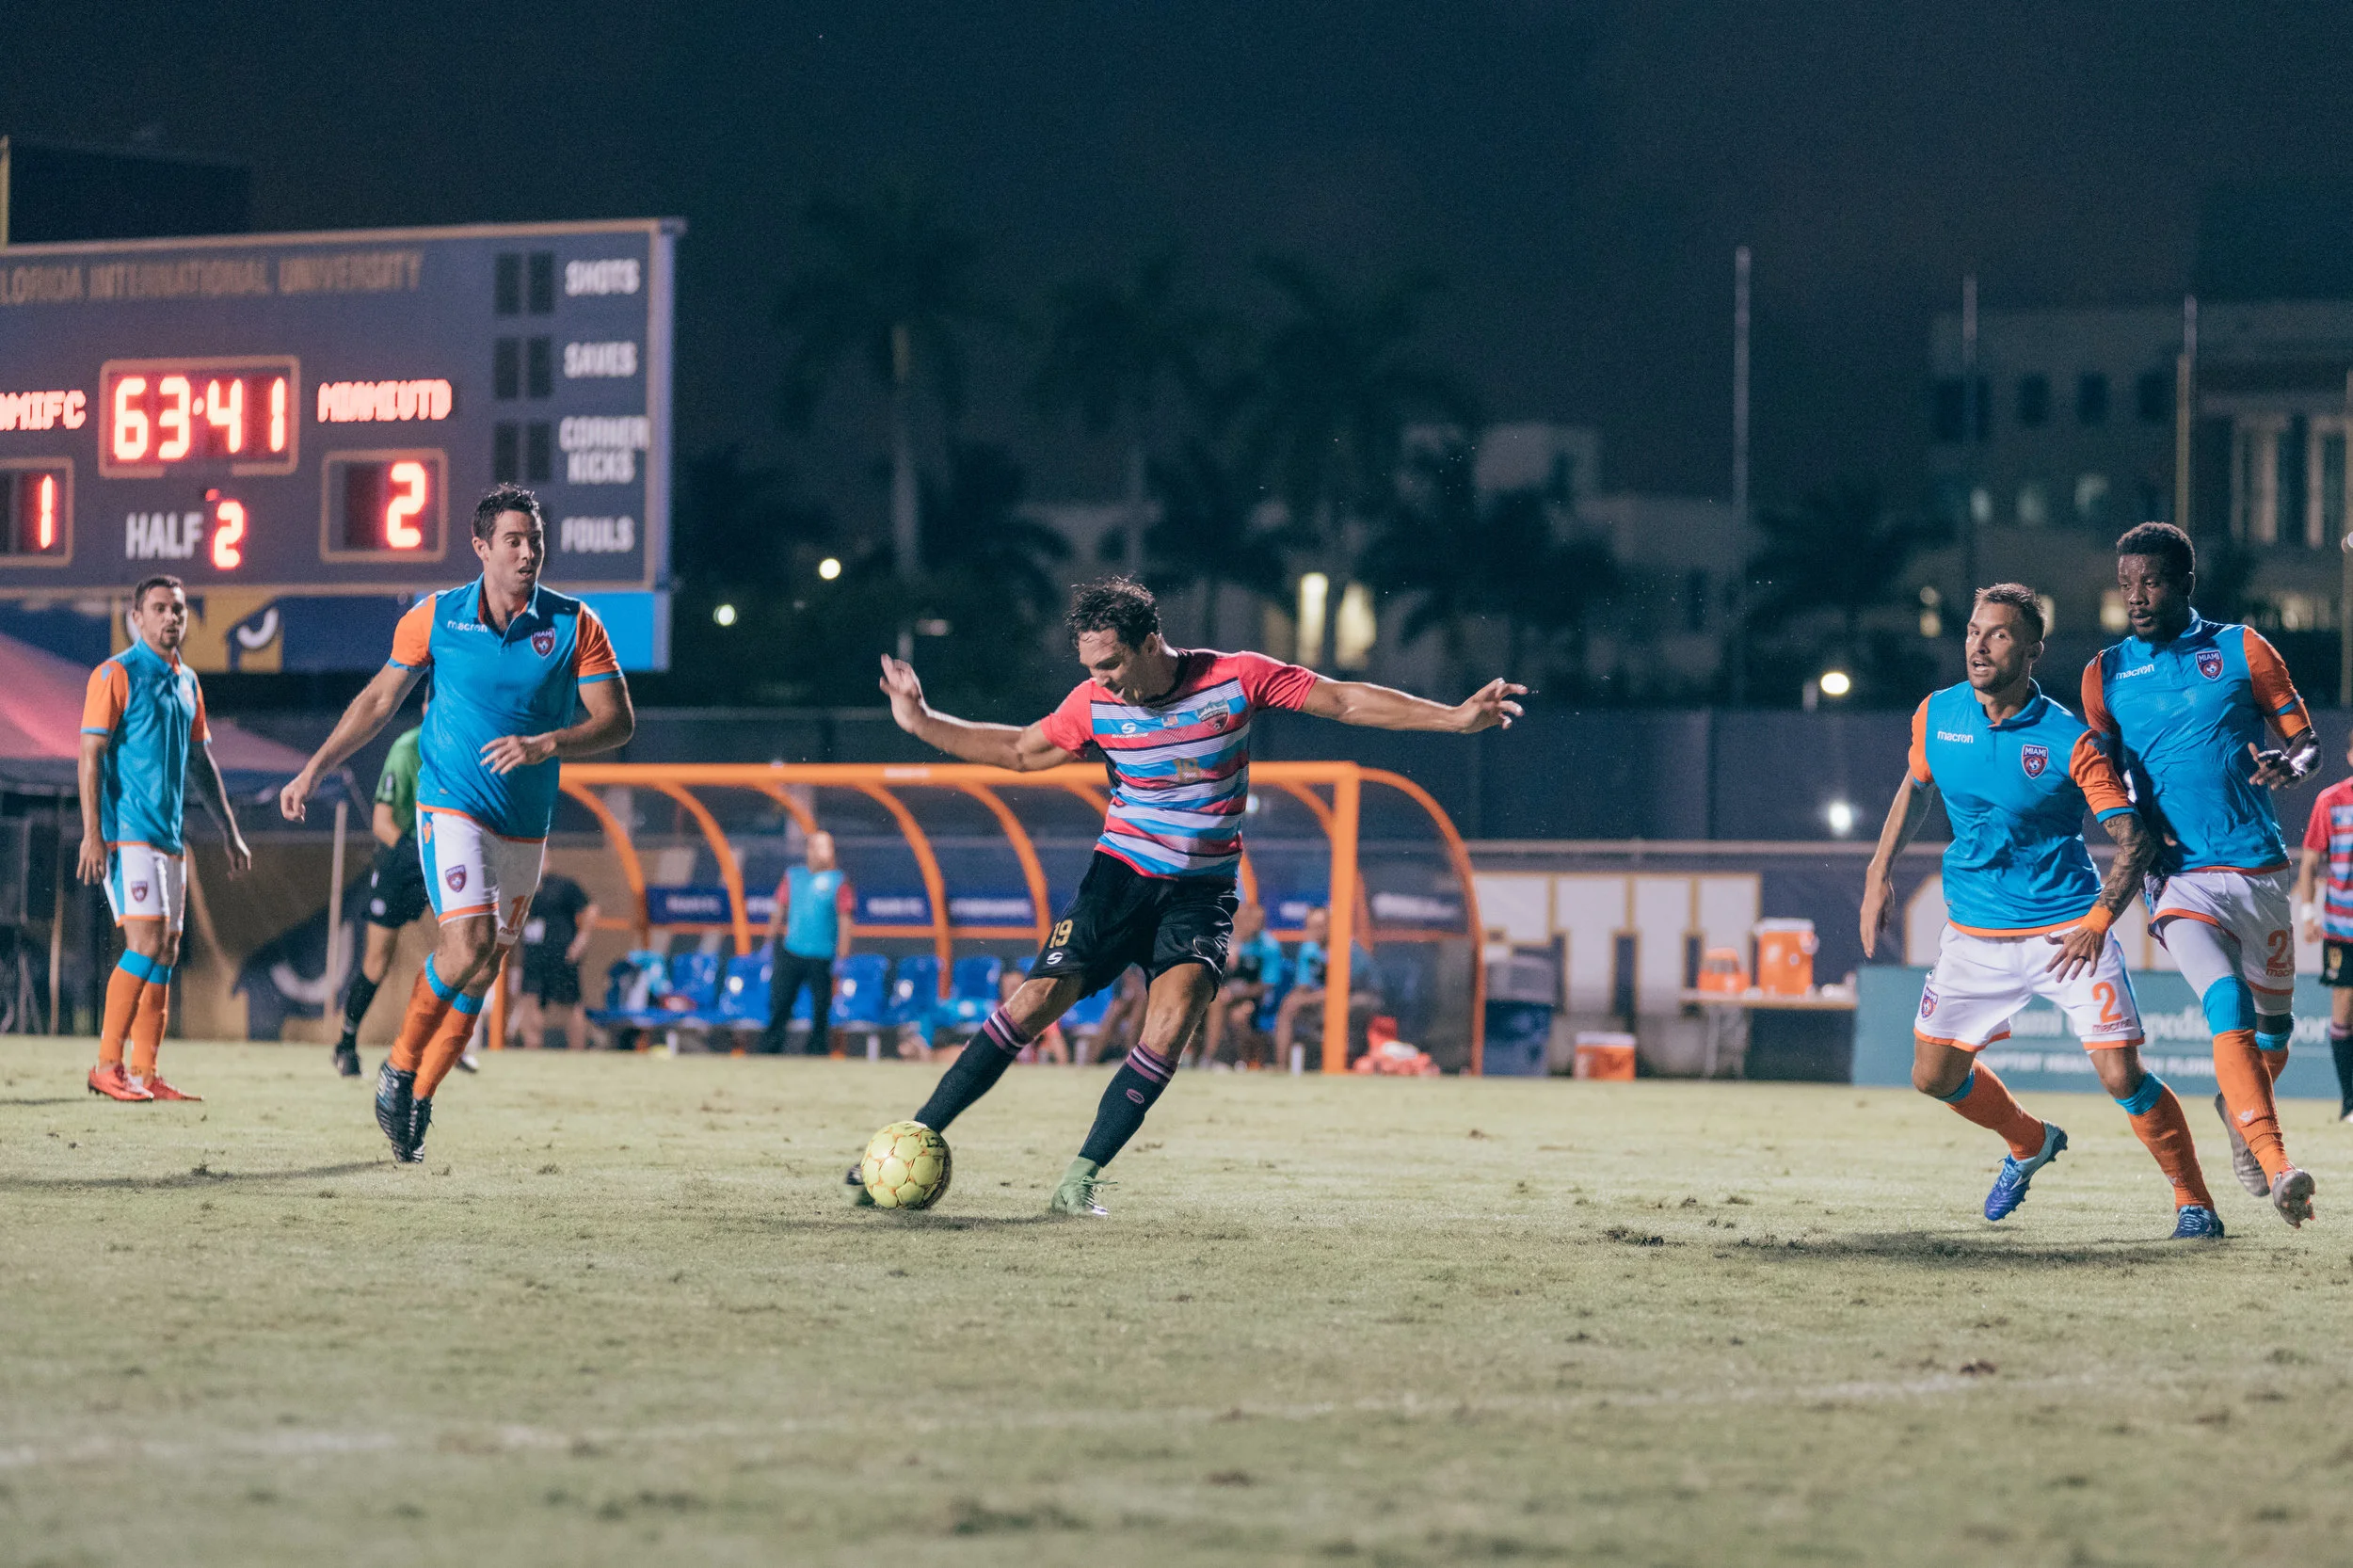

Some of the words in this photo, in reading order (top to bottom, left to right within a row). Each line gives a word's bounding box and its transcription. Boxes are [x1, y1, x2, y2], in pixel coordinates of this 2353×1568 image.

[0, 265, 83, 304] LORIDA
[565, 259, 640, 295] SHOTS
[564, 342, 637, 377] SAVES
[40, 474, 54, 549] 1
[386, 461, 426, 548] 2
[126, 512, 203, 559] HALF
[213, 500, 245, 569] 2
[561, 517, 635, 552] FOULS
[447, 620, 488, 633] macron
[2116, 664, 2154, 680] macron
[2198, 652, 2220, 664] MIAMI
[1937, 730, 1974, 744] macron
[2025, 747, 2047, 757] MIAMI
[1048, 920, 1074, 949] 19
[2091, 982, 2122, 1023] 2
